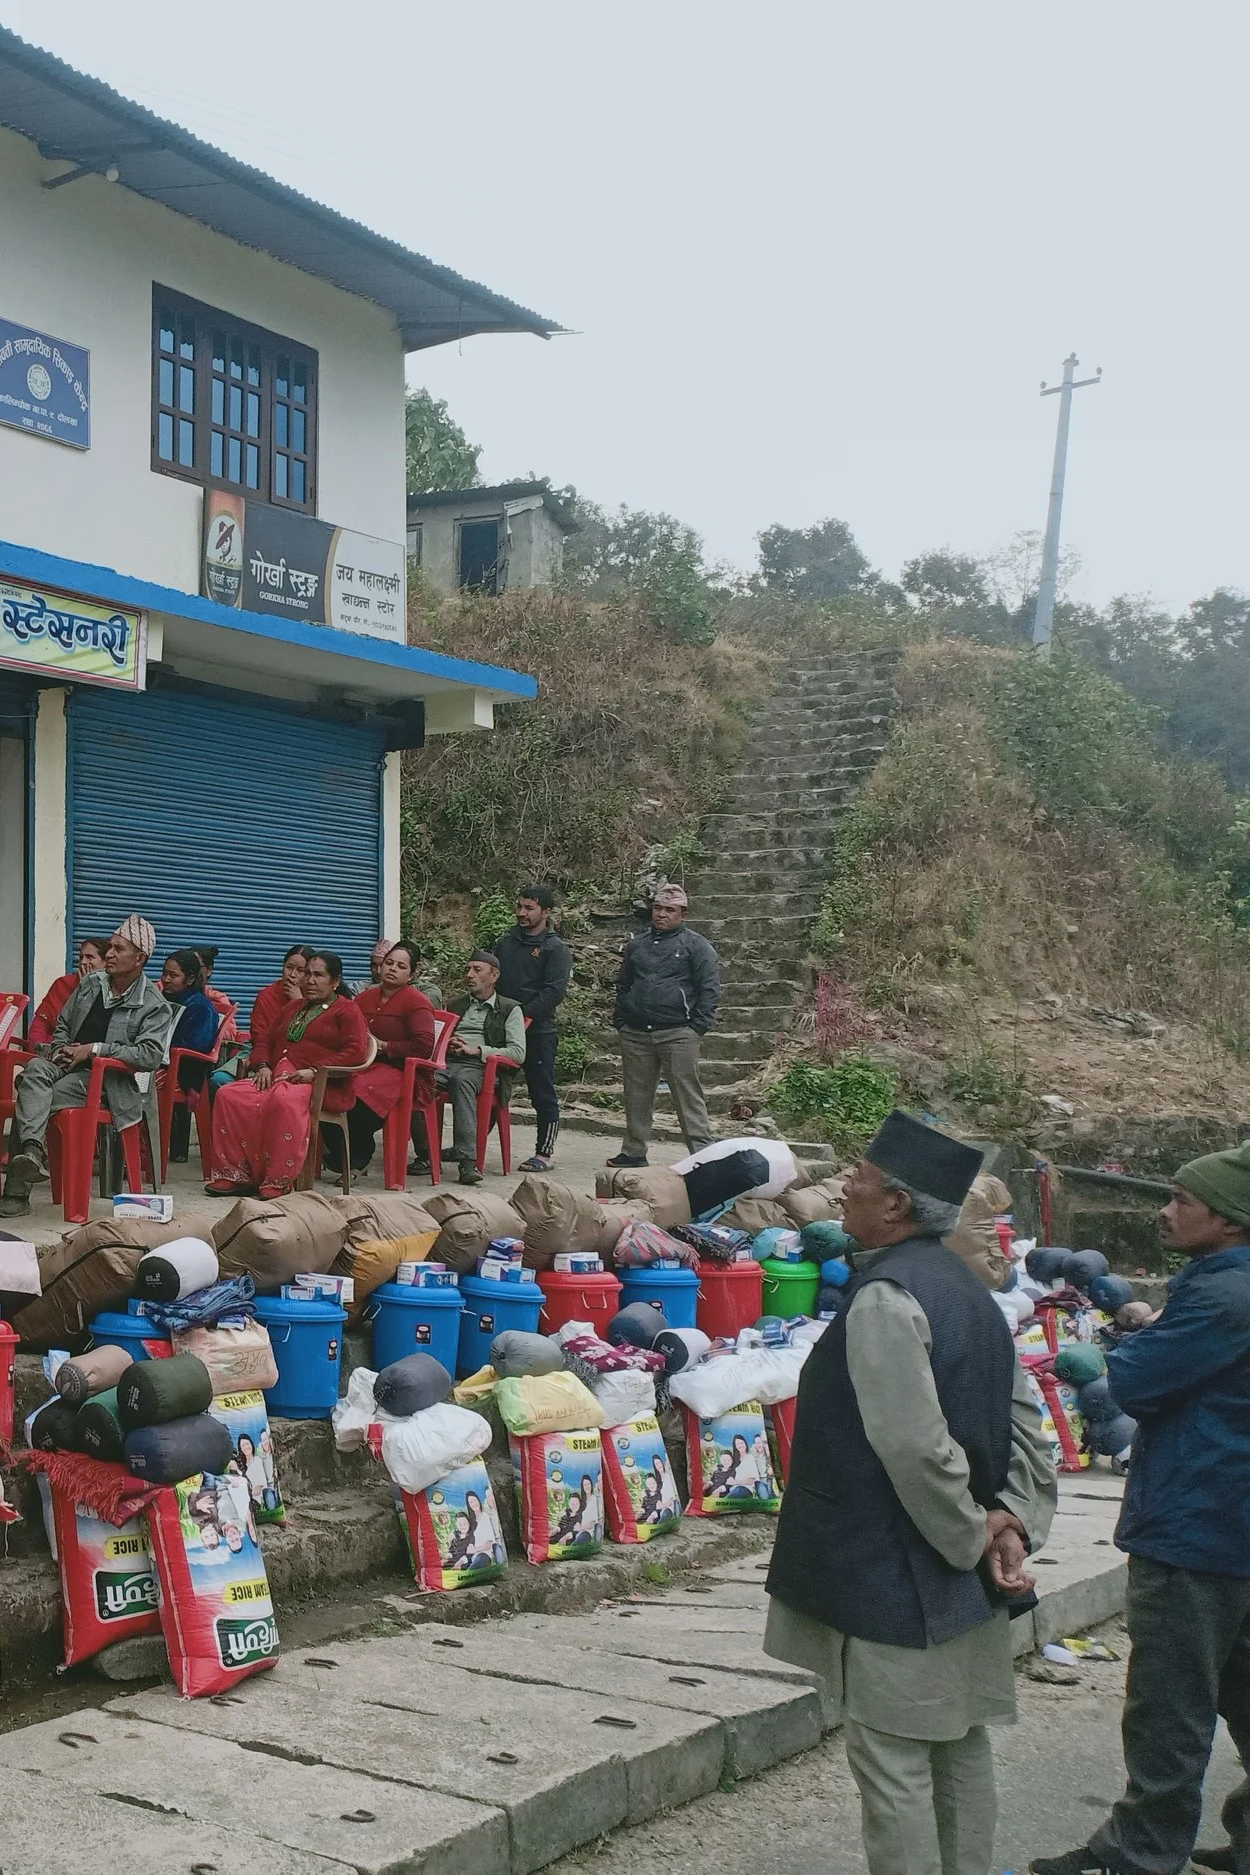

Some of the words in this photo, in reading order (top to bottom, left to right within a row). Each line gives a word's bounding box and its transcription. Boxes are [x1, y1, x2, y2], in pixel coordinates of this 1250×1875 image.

[249, 550, 286, 589] गोर्खा
[336, 564, 354, 583] जय
[359, 570, 401, 595] महालक्ष्मी
[259, 590, 285, 604] GORKHA
[377, 599, 395, 617] स्टोर
[2, 594, 129, 662] स्टेसनरी
[113, 1538, 139, 1555] RICE
[231, 1584, 253, 1600] RICE
